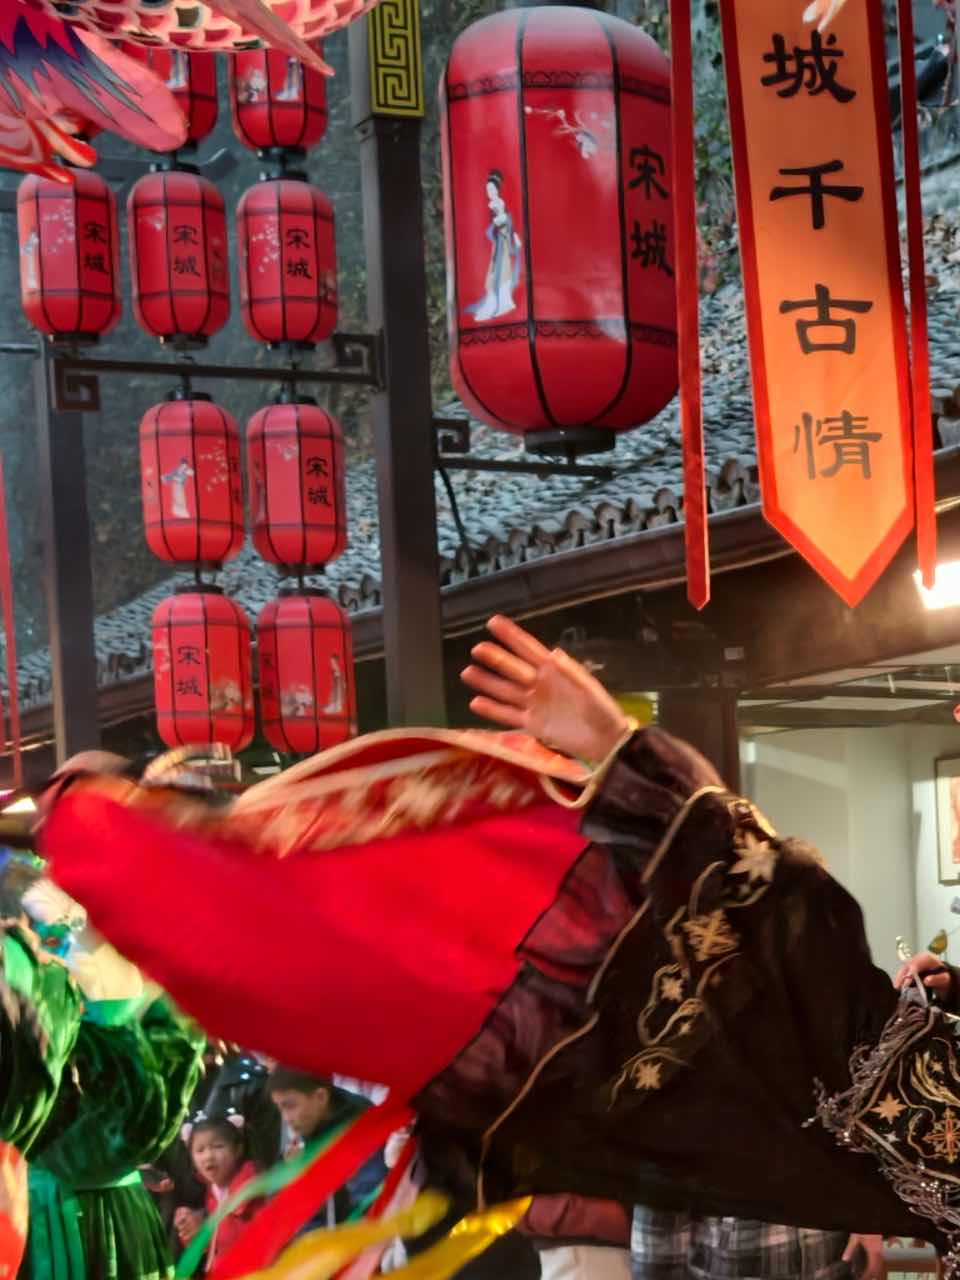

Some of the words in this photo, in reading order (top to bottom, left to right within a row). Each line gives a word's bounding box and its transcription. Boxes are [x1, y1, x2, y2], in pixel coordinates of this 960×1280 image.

[628, 143, 674, 278] 宋城
[83, 220, 110, 276] 宋城
[172, 224, 201, 279] 宋城
[286, 227, 313, 280] 宋城
[761, 29, 883, 481] 城千古情
[305, 457, 332, 507] 宋城
[176, 645, 203, 697] 宋城
